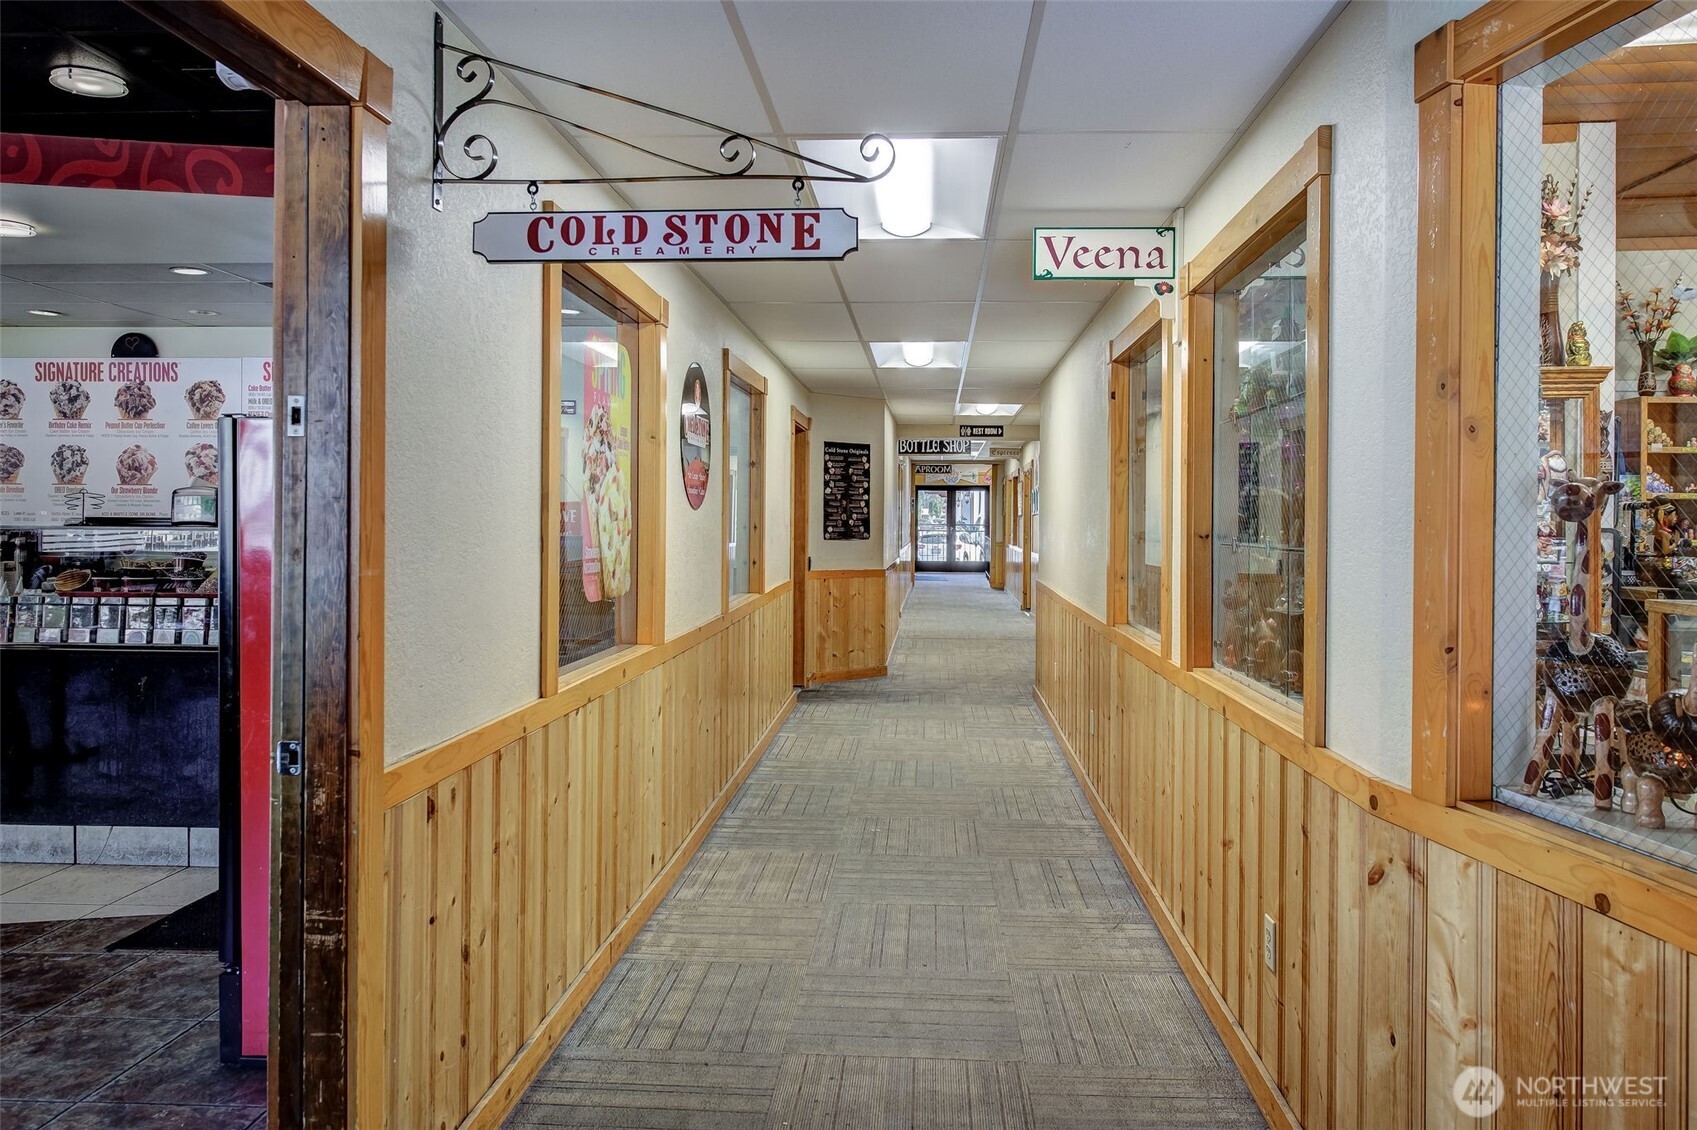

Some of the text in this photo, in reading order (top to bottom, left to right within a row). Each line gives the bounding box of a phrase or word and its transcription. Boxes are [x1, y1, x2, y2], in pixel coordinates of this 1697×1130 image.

[527, 212, 822, 254] COLD STONE
[588, 245, 759, 256] CREAMERY
[1039, 236, 1169, 270] Veena
[34, 361, 179, 382] SIGNATURE CREATIONS
[900, 440, 970, 453] BOTTLE SHOP
